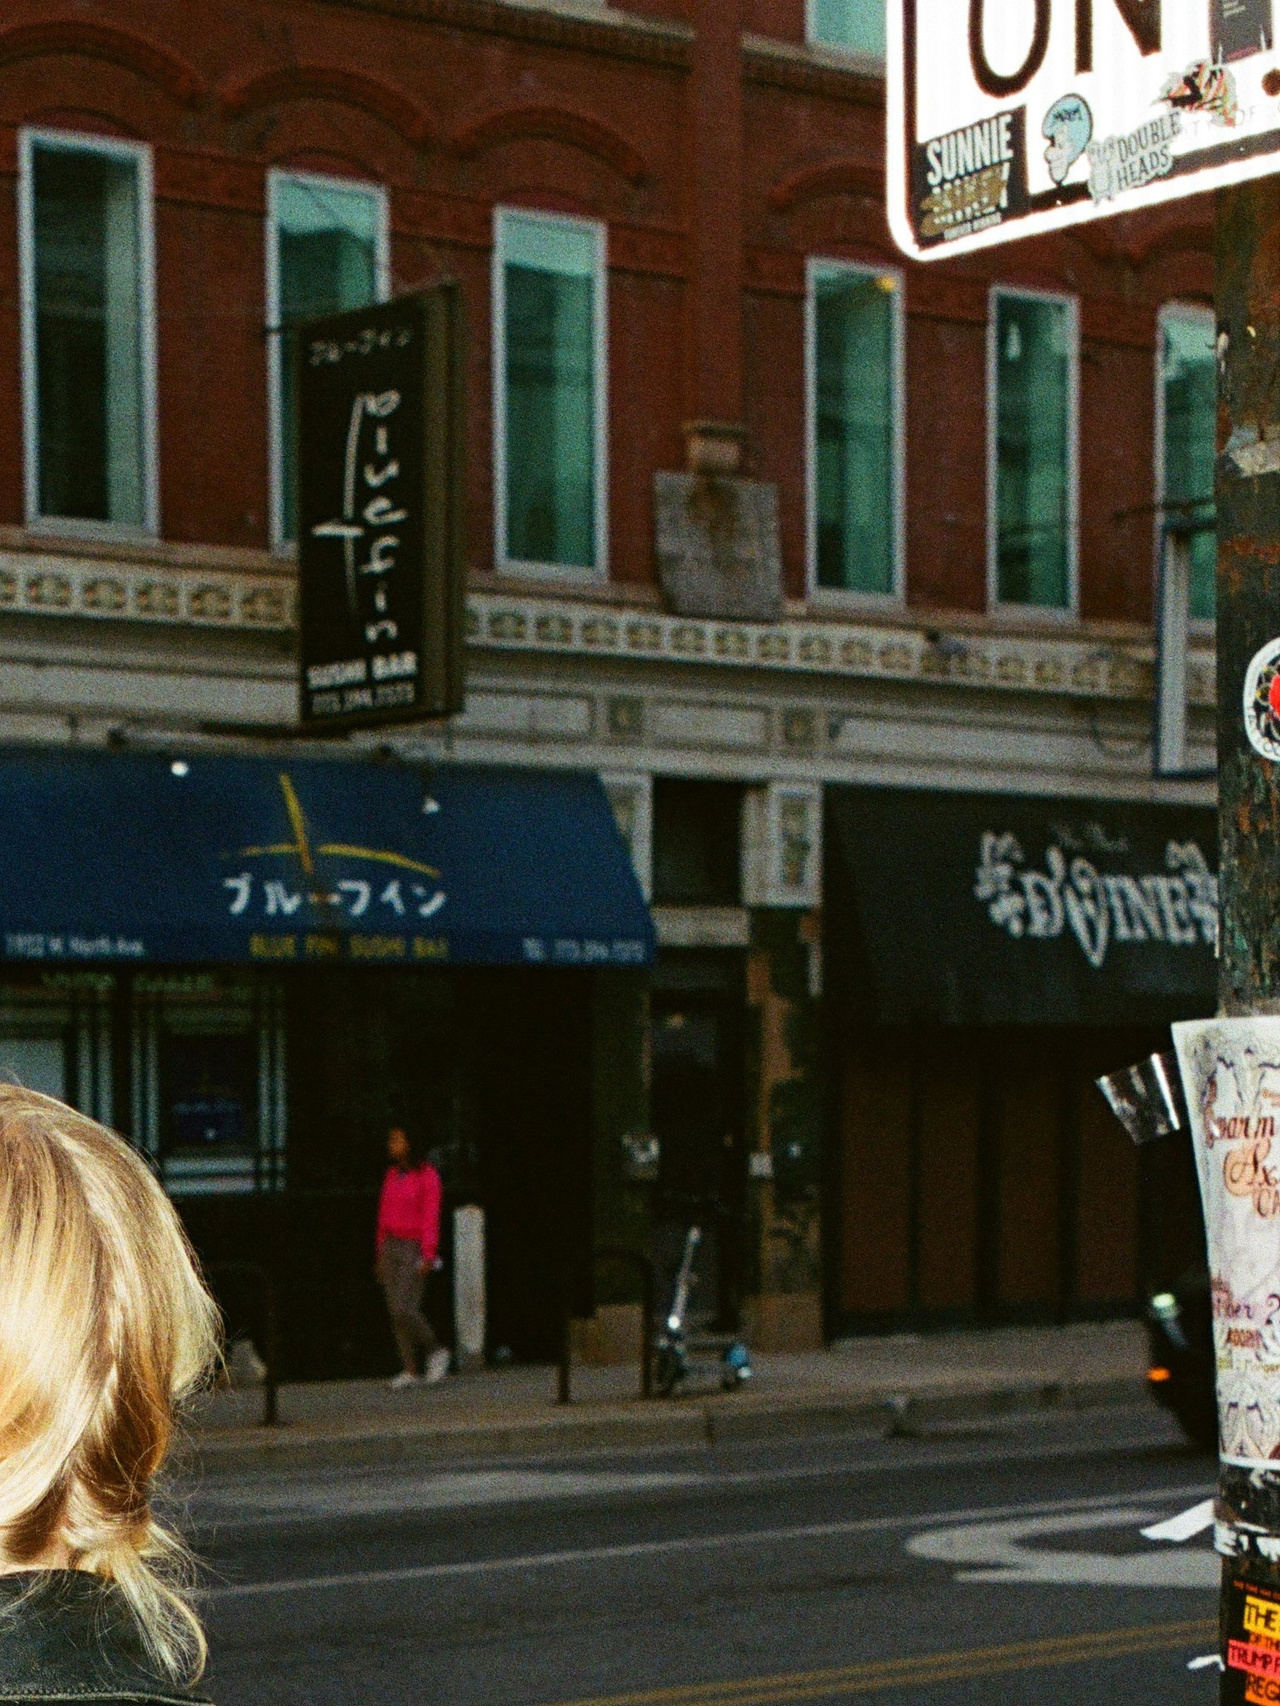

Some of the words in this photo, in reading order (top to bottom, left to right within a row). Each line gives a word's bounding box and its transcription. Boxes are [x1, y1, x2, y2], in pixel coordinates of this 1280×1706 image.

[926, 114, 1014, 186] SUNNIE
[1119, 110, 1181, 162] DOUBLE
[1117, 148, 1171, 190] HEADS
[1245, 1602, 1278, 1632] THE
[1230, 1644, 1273, 1670] TRUMP
[1246, 1671, 1280, 1702] REG
